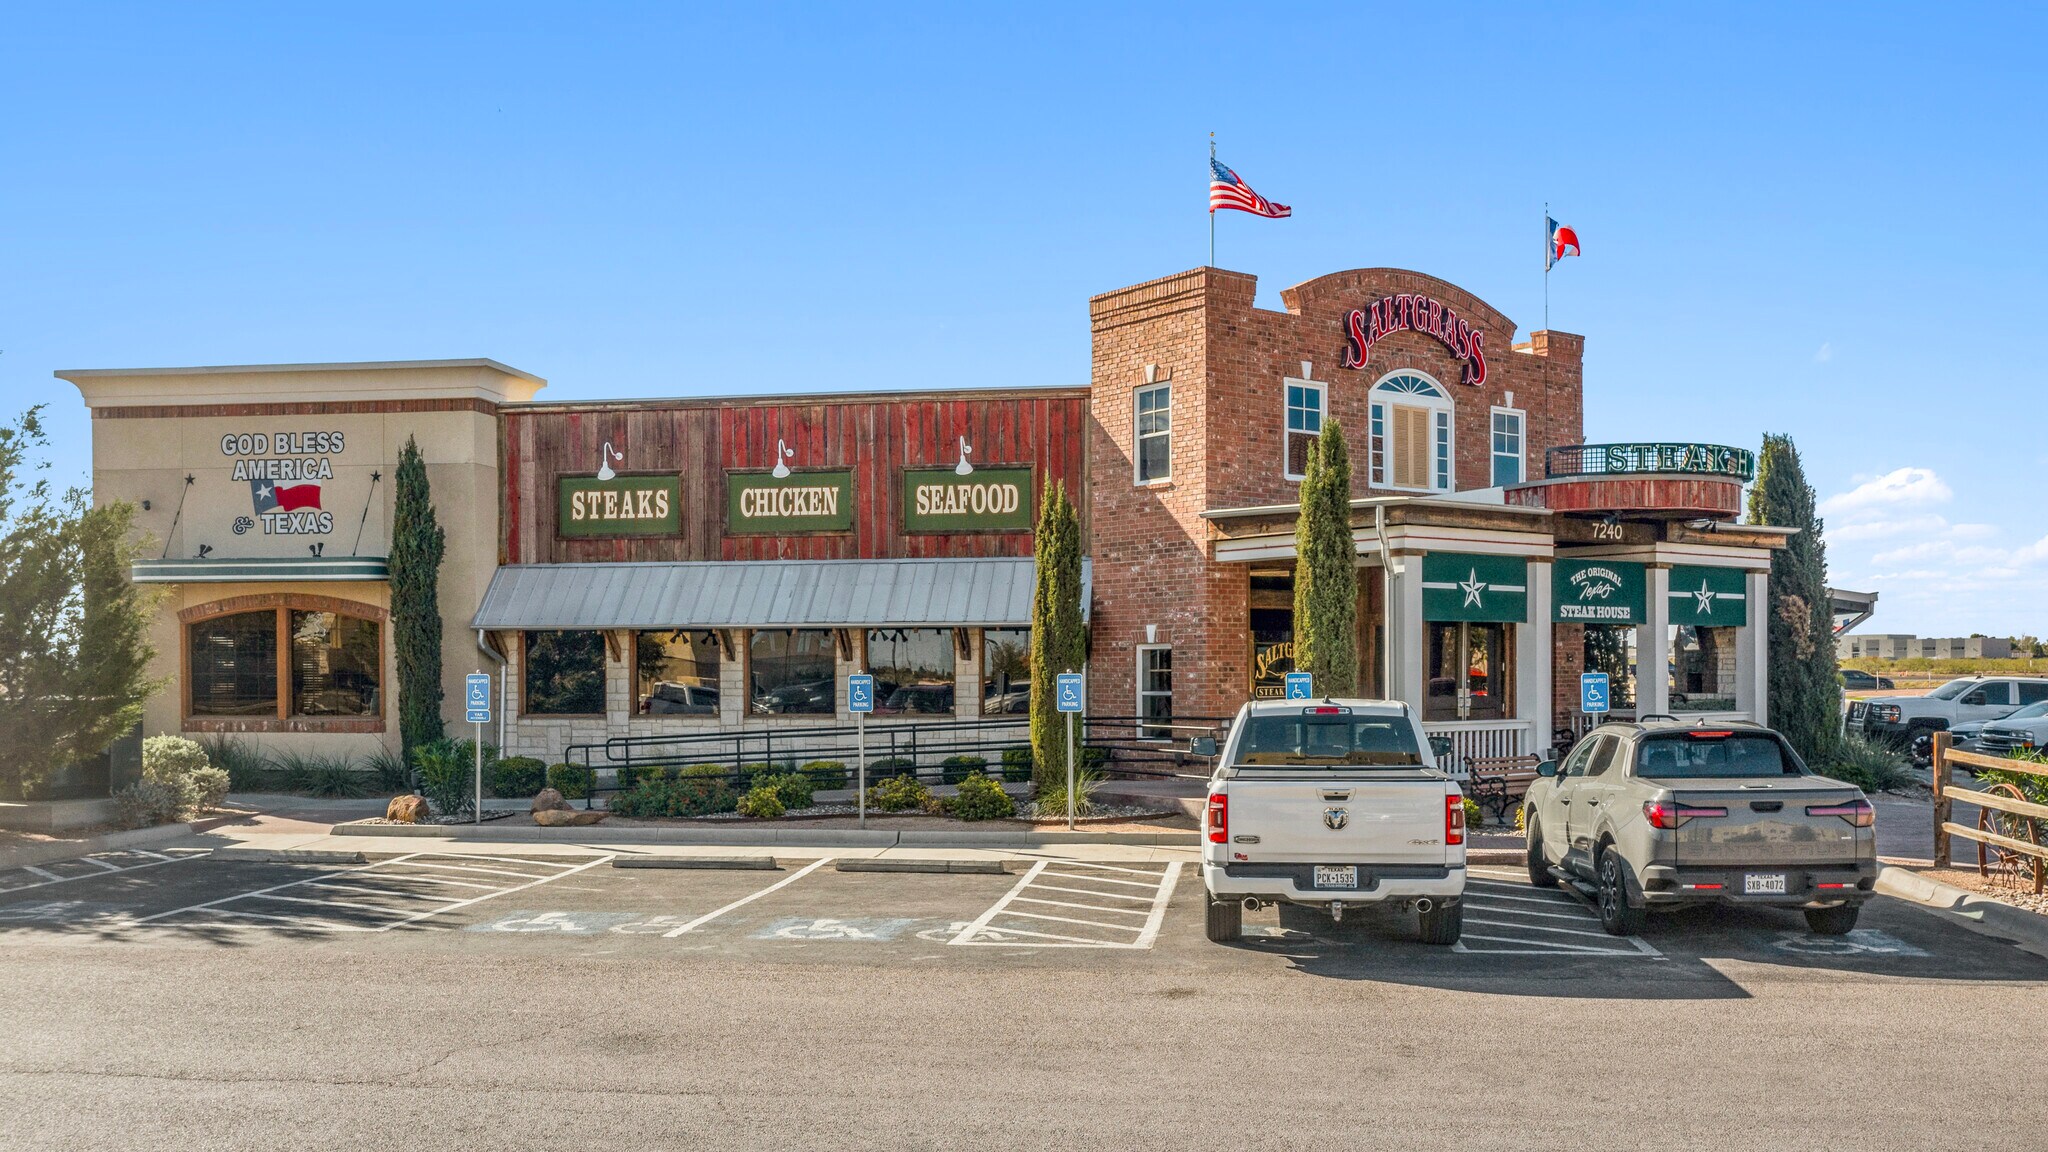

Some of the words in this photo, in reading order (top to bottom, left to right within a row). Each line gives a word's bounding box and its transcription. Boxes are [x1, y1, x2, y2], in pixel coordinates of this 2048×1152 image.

[1345, 294, 1487, 386] SALTGRASS
[220, 433, 269, 456] GOD
[274, 431, 345, 455] BLESS
[231, 457, 333, 481] AMERICA
[572, 489, 669, 520] STEAKS
[740, 486, 839, 517] CHICKEN
[916, 483, 1018, 515] SEAFOOD
[232, 516, 254, 535] &
[260, 511, 334, 535] TEXAS
[1592, 522, 1623, 540] 7240
[1570, 569, 1587, 586] THE
[1587, 567, 1622, 588] ORIGINAL
[1560, 604, 1596, 618] STEAK
[1597, 606, 1631, 619] HOUSE
